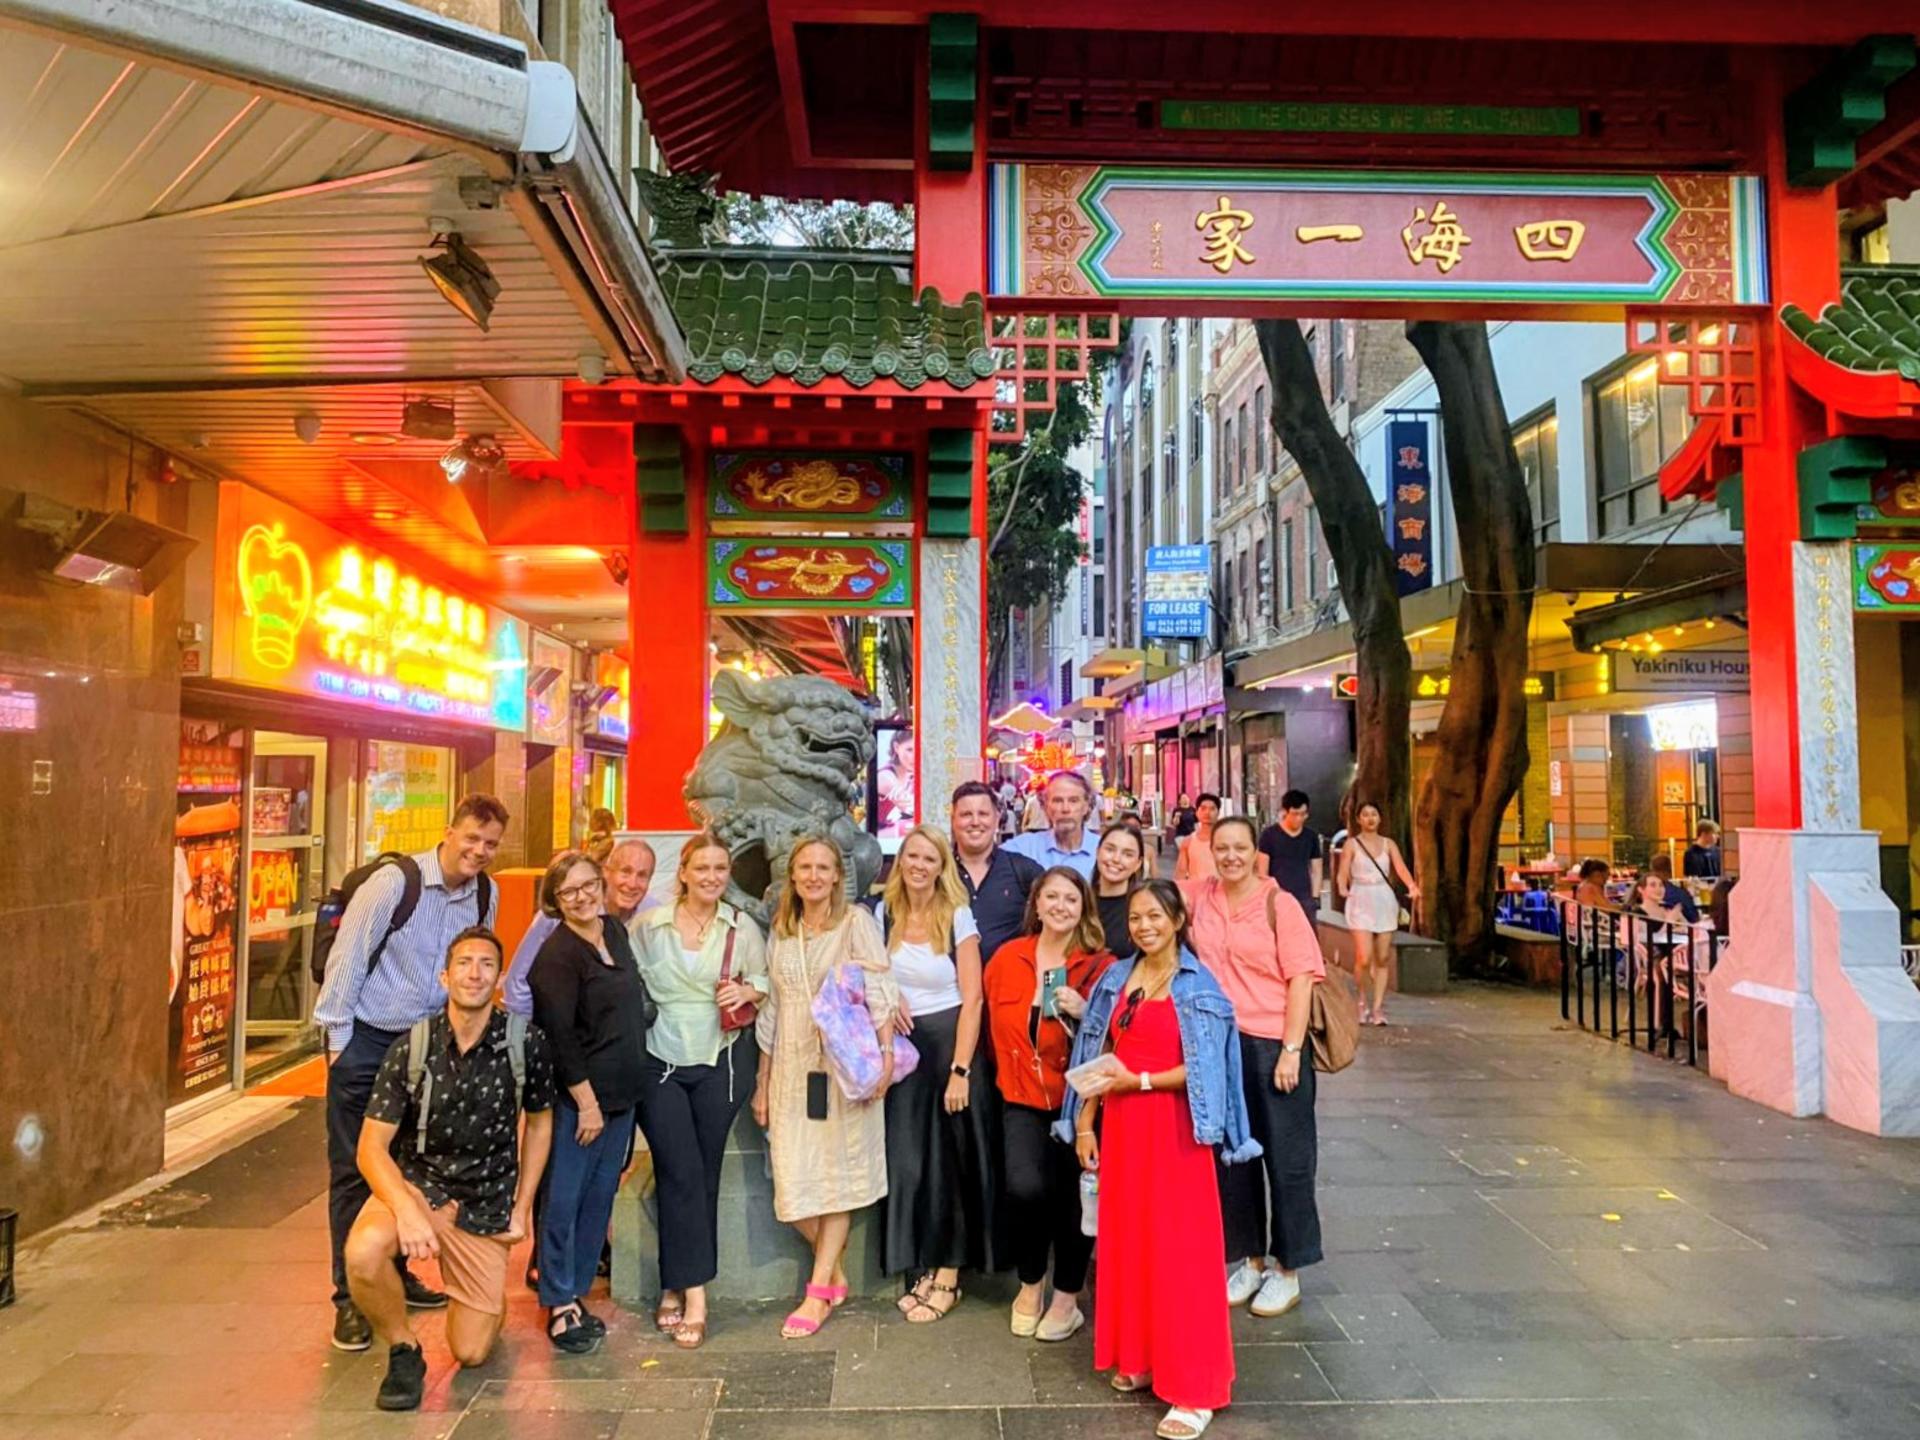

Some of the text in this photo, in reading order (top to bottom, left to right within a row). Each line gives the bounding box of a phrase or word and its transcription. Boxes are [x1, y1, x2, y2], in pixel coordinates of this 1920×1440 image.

[1338, 108, 1382, 128] SEAS
[1423, 109, 1454, 130] ARE
[1148, 602, 1201, 615] FOR LEASE
[1631, 656, 1706, 674] Yakiniku
[249, 861, 298, 909] OPEN
